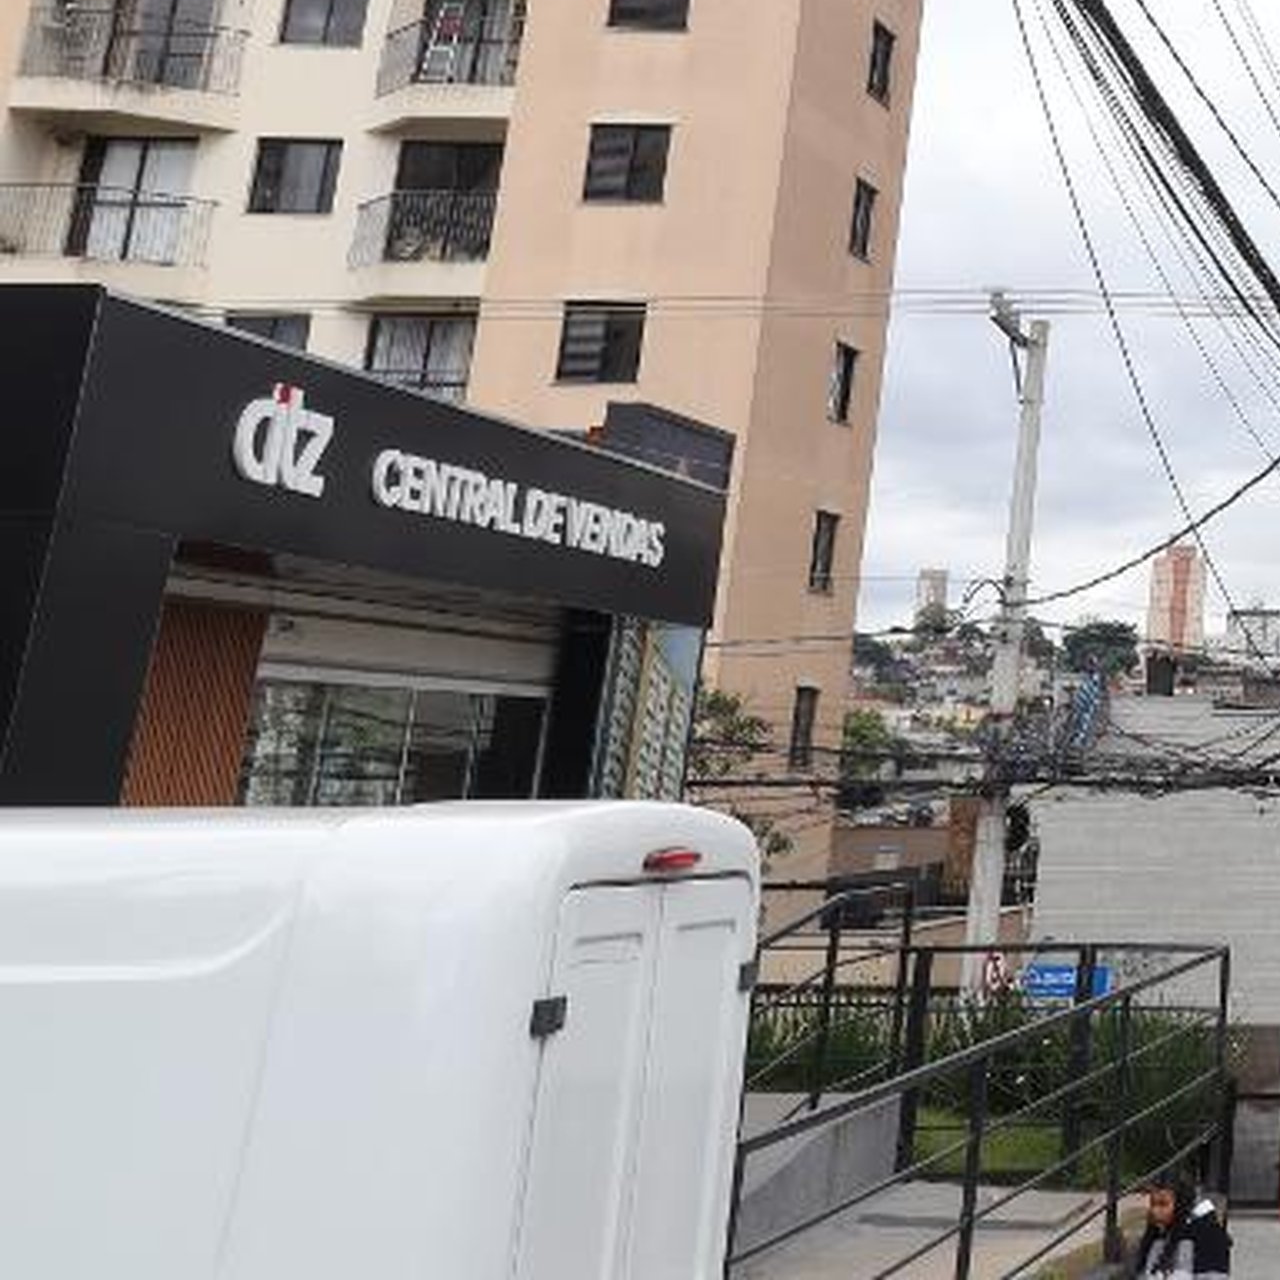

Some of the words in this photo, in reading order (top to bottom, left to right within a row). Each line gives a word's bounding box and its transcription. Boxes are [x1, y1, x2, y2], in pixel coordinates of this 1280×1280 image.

[372, 448, 520, 533] CENTRAL
[523, 488, 567, 545] DE
[566, 496, 666, 568] VENDAS
